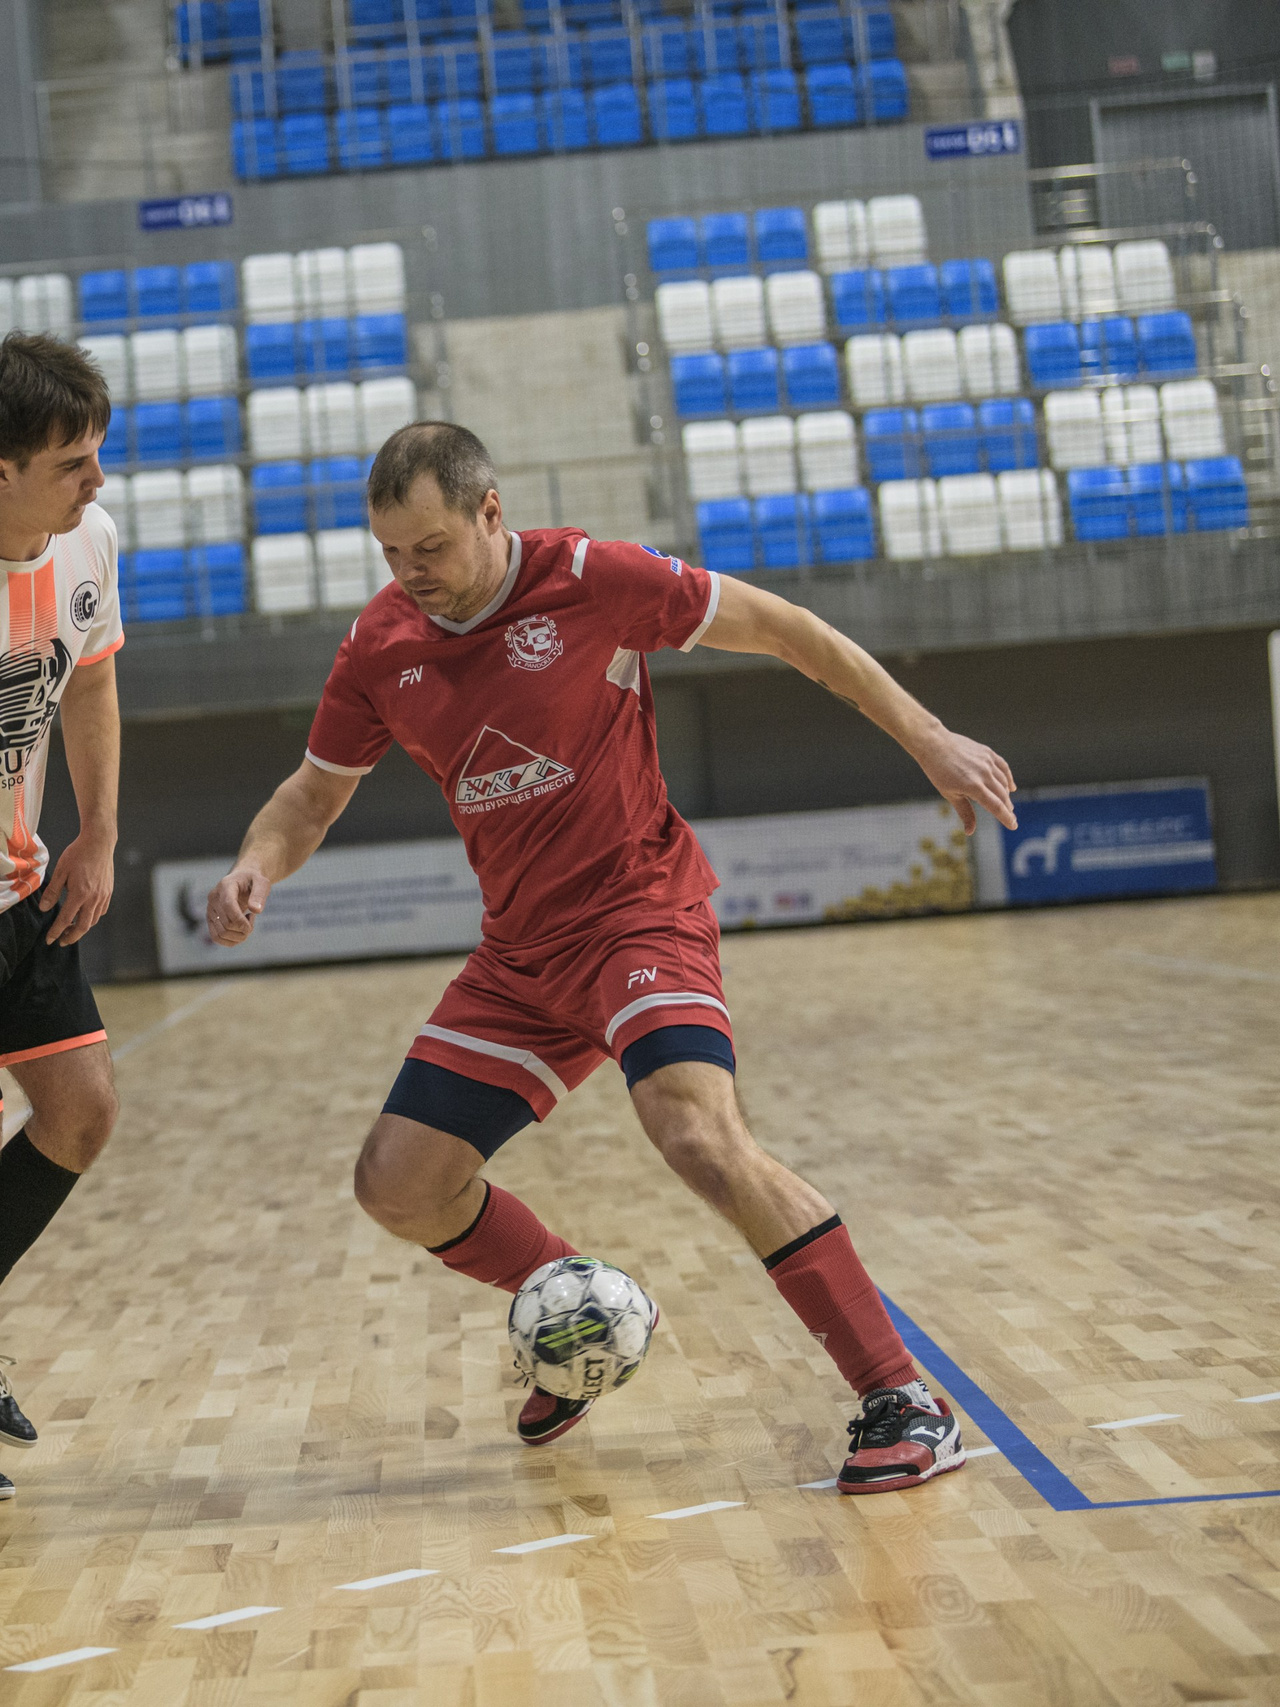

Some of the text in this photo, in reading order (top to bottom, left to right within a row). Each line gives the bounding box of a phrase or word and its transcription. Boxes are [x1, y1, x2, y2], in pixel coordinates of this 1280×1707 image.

[524, 656, 553, 669] PANDORA
[399, 664, 423, 689] FN
[485, 789, 532, 811] БУДУЩЕЕ
[533, 772, 577, 797] ВМЕСТЕ
[627, 966, 658, 990] FN
[580, 1357, 605, 1400] ELECT
